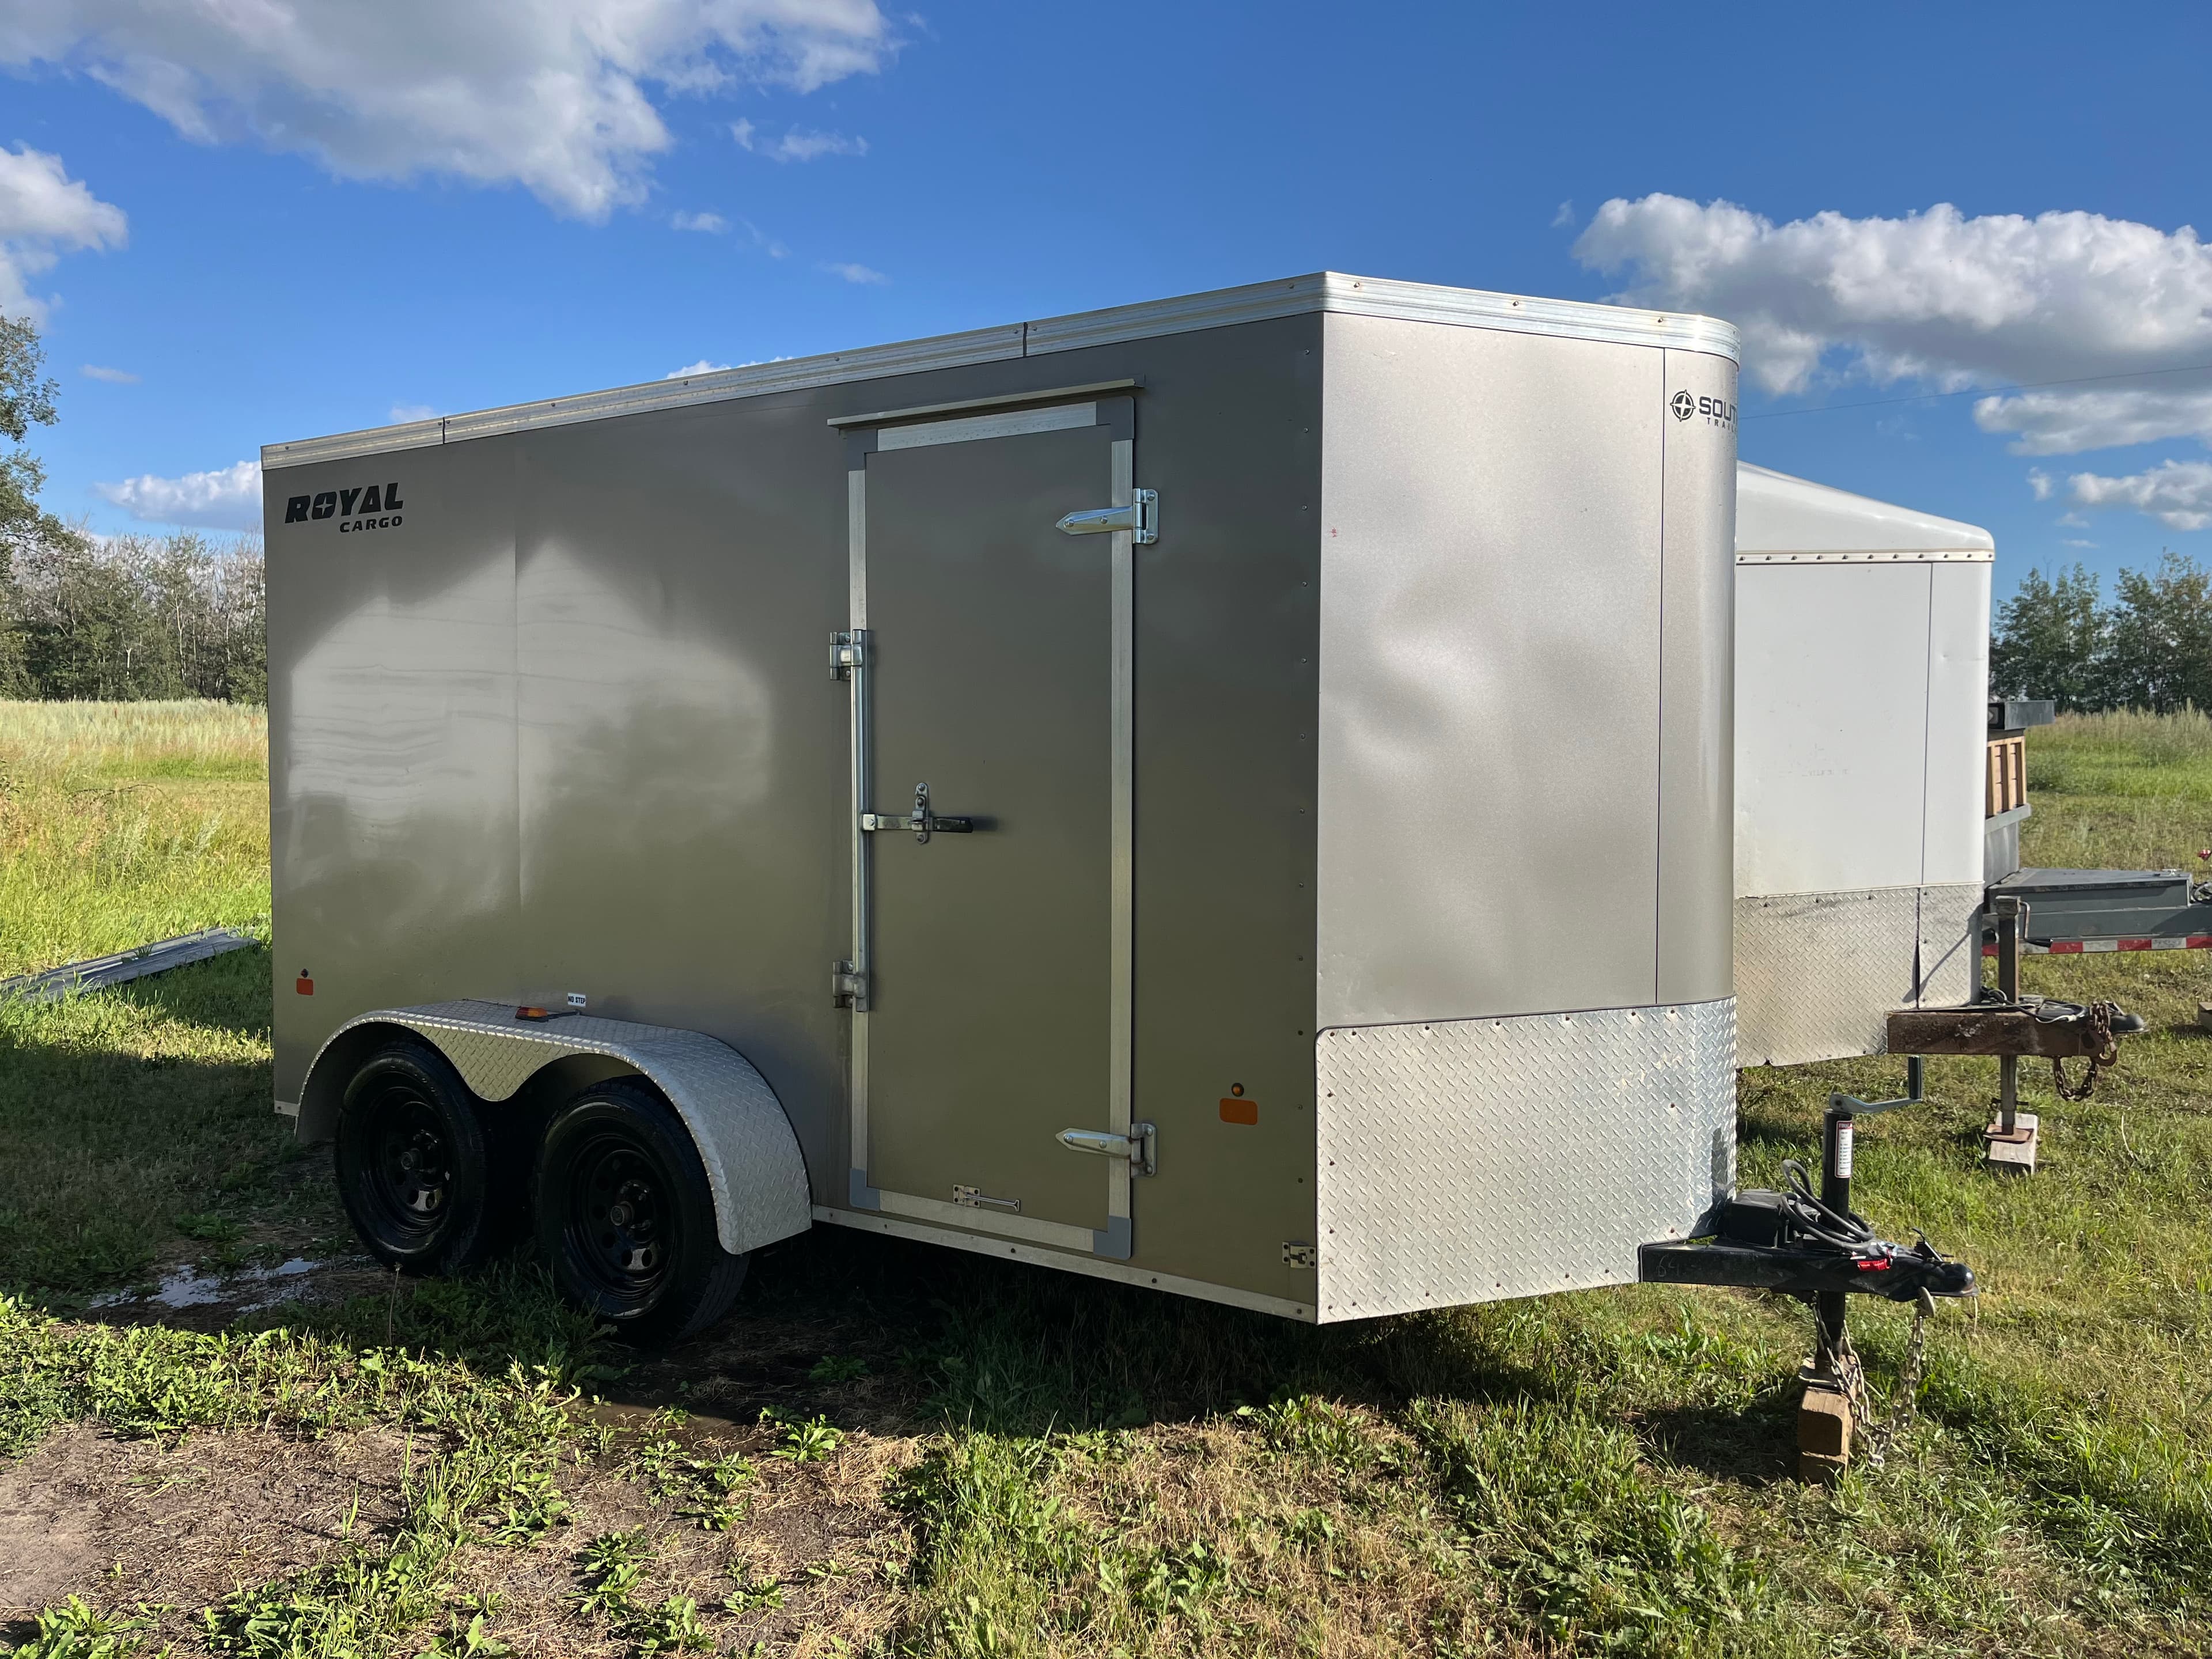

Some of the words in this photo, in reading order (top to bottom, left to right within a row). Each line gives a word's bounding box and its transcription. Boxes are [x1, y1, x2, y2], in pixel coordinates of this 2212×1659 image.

[1699, 396, 1737, 425] SOUT
[285, 482, 404, 524] ROYAL
[339, 516, 403, 533] CARGO
